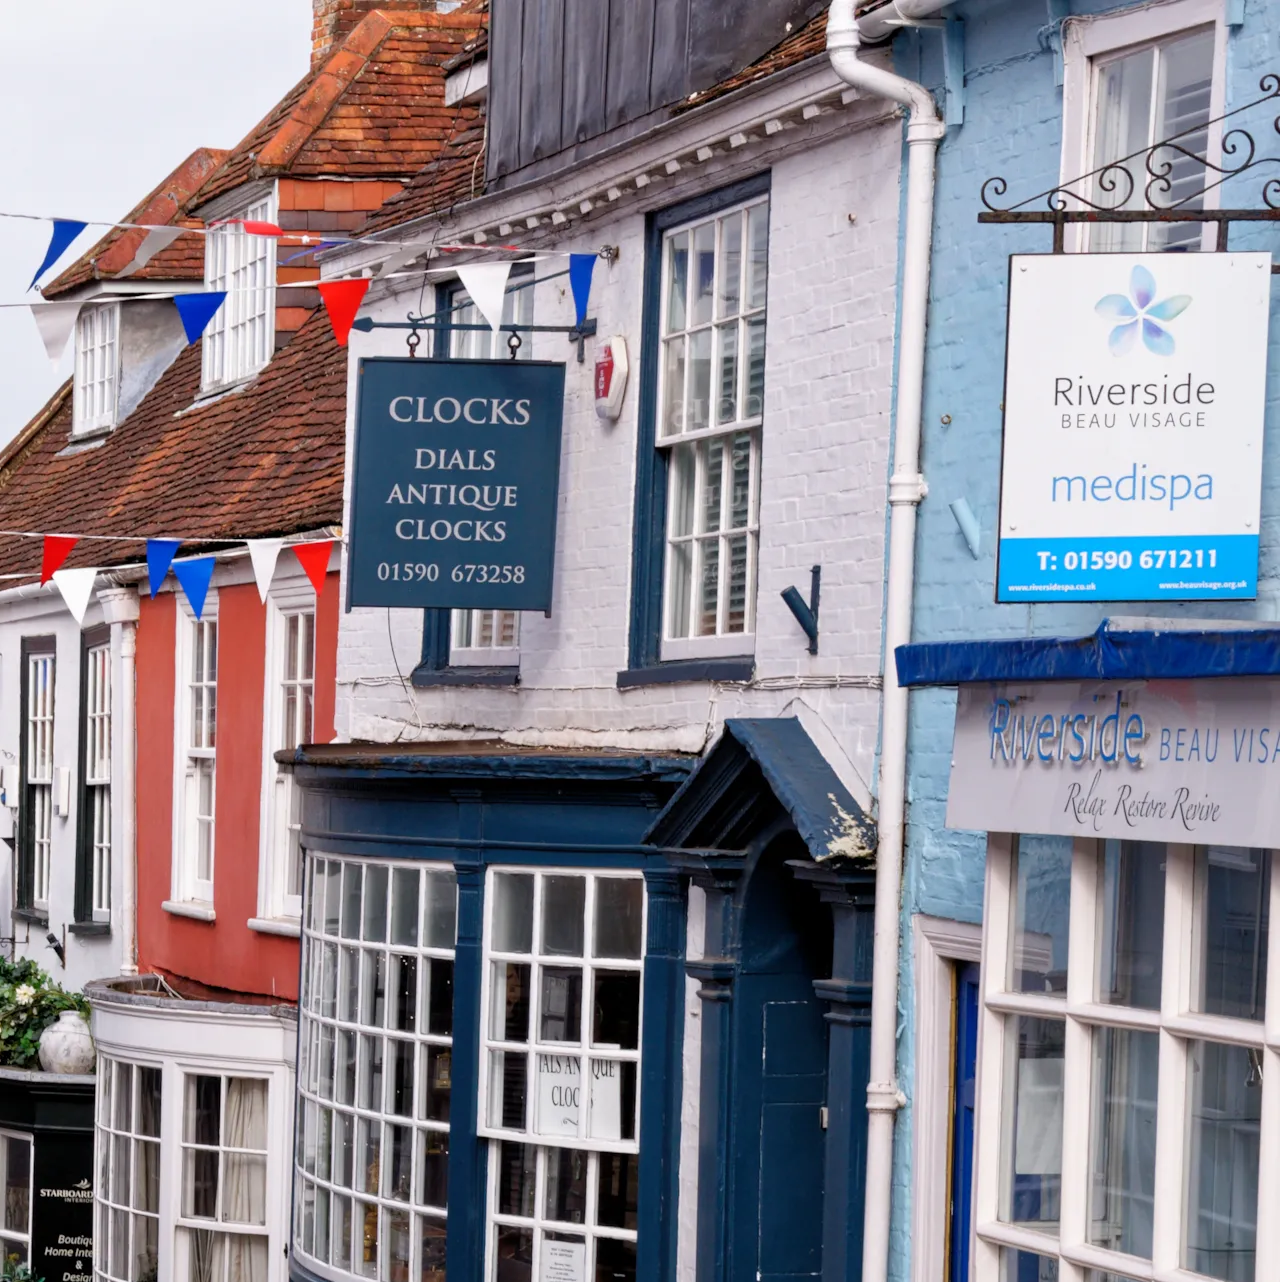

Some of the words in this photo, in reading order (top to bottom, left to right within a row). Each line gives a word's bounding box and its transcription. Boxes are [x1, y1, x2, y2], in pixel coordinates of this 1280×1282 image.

[1053, 372, 1215, 406] Riverside
[389, 396, 531, 426] CLOCKS
[1061, 413, 1117, 428] BEAU
[1129, 412, 1206, 428] VISAGE
[414, 448, 496, 471] DIALS
[385, 483, 518, 512] ANTIQUE
[1051, 462, 1213, 511] medispa
[395, 518, 507, 542] CLOCKS
[1037, 551, 1057, 570] T:
[1063, 550, 1132, 570] 01590
[1139, 549, 1217, 569] 671211
[377, 562, 439, 582] 01590
[451, 564, 525, 584] 673258
[1158, 579, 1247, 590] www.beauvisage.org.uk
[1008, 581, 1096, 592] www.riversidespa.co.uk
[989, 690, 1146, 764] Riverside
[1159, 728, 1219, 762] BEAU
[1233, 728, 1280, 764] VISA
[1064, 769, 1106, 831] Relax
[1113, 783, 1168, 831] Restore
[1170, 786, 1221, 831] Revive
[564, 1055, 615, 1080] ANQUE
[551, 1085, 593, 1109] CLOC
[40, 1188, 93, 1199] STARBOARD
[44, 1246, 73, 1257] Home
[75, 1247, 93, 1258] Inte
[57, 1234, 93, 1247] Boutiqu
[75, 1260, 83, 1270] &
